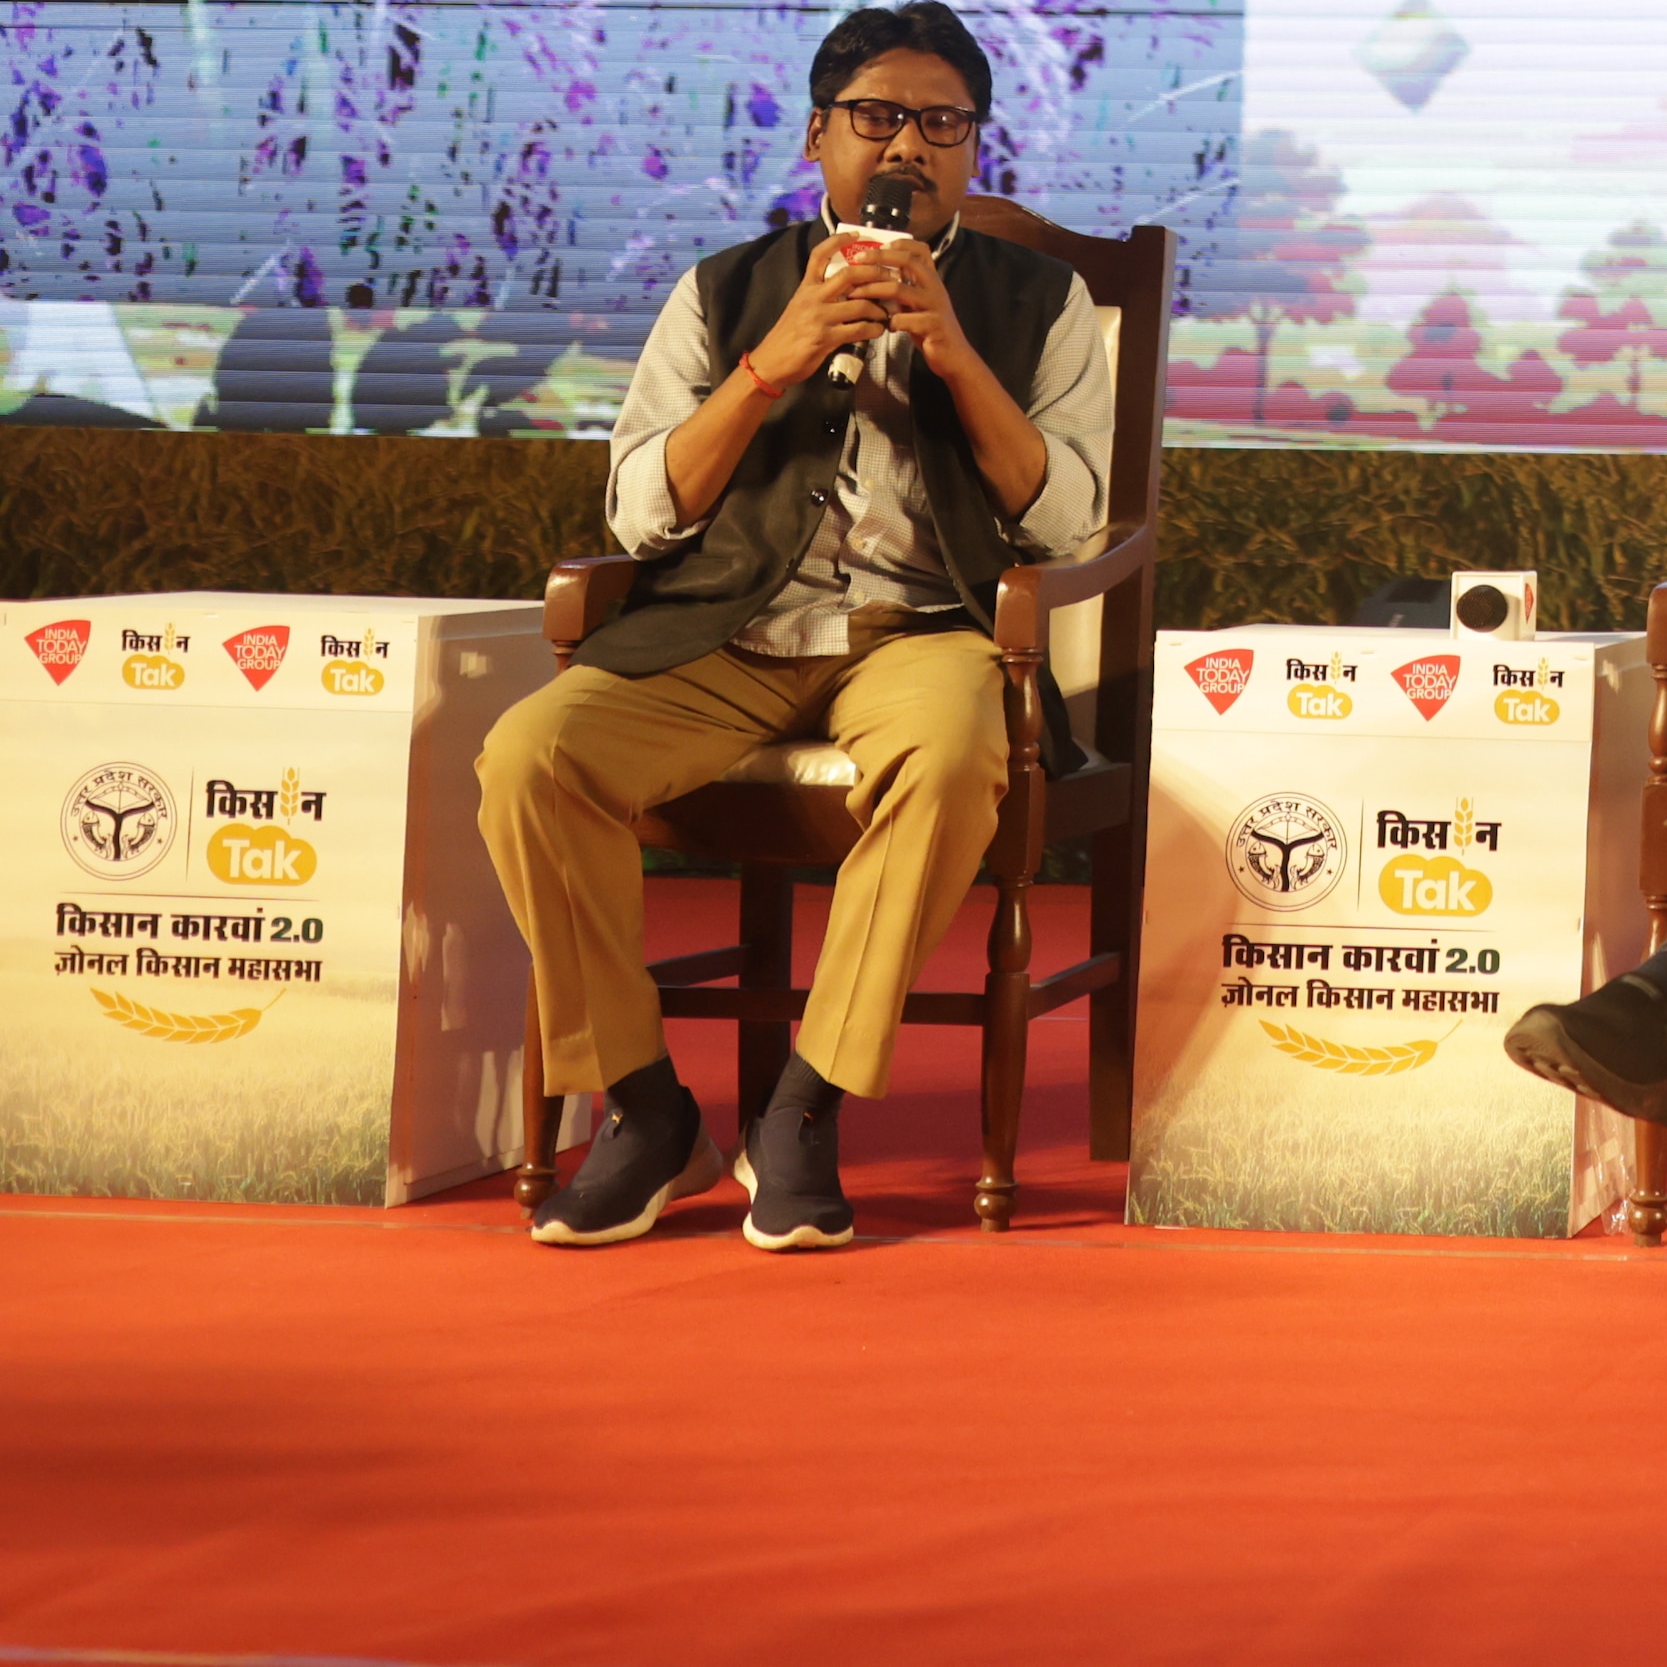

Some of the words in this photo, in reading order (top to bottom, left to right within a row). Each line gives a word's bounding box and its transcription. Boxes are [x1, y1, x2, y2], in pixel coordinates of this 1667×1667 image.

[44, 629, 78, 640] INDIA
[242, 634, 277, 646] INDIA
[36, 639, 87, 653] TODAY
[234, 645, 285, 659] TODAY
[39, 653, 82, 664] GROUP
[237, 659, 281, 670] GROUP
[1205, 658, 1240, 669] INDIA
[131, 663, 176, 686] Tak
[1196, 668, 1249, 683] TODAY
[1412, 664, 1448, 675] INDIA
[330, 668, 375, 692] Tak
[1403, 675, 1456, 689] TODAY
[1200, 682, 1245, 694] GROUP
[1407, 688, 1451, 700] GROUP
[1296, 692, 1342, 715] Tak
[1503, 698, 1550, 722] Tak
[223, 838, 301, 880] Tak
[1394, 870, 1476, 911] Tak
[56, 903, 162, 937] किसान
[171, 908, 265, 942] कारवां
[270, 917, 323, 943] 2.0
[1222, 934, 1333, 971] किसान
[1342, 939, 1440, 973] कारवां
[1445, 949, 1500, 974] 2.0
[137, 948, 221, 978] किसान
[228, 958, 322, 981] महासभा
[1307, 979, 1394, 1011] किसान
[1402, 989, 1499, 1013] महासभा
